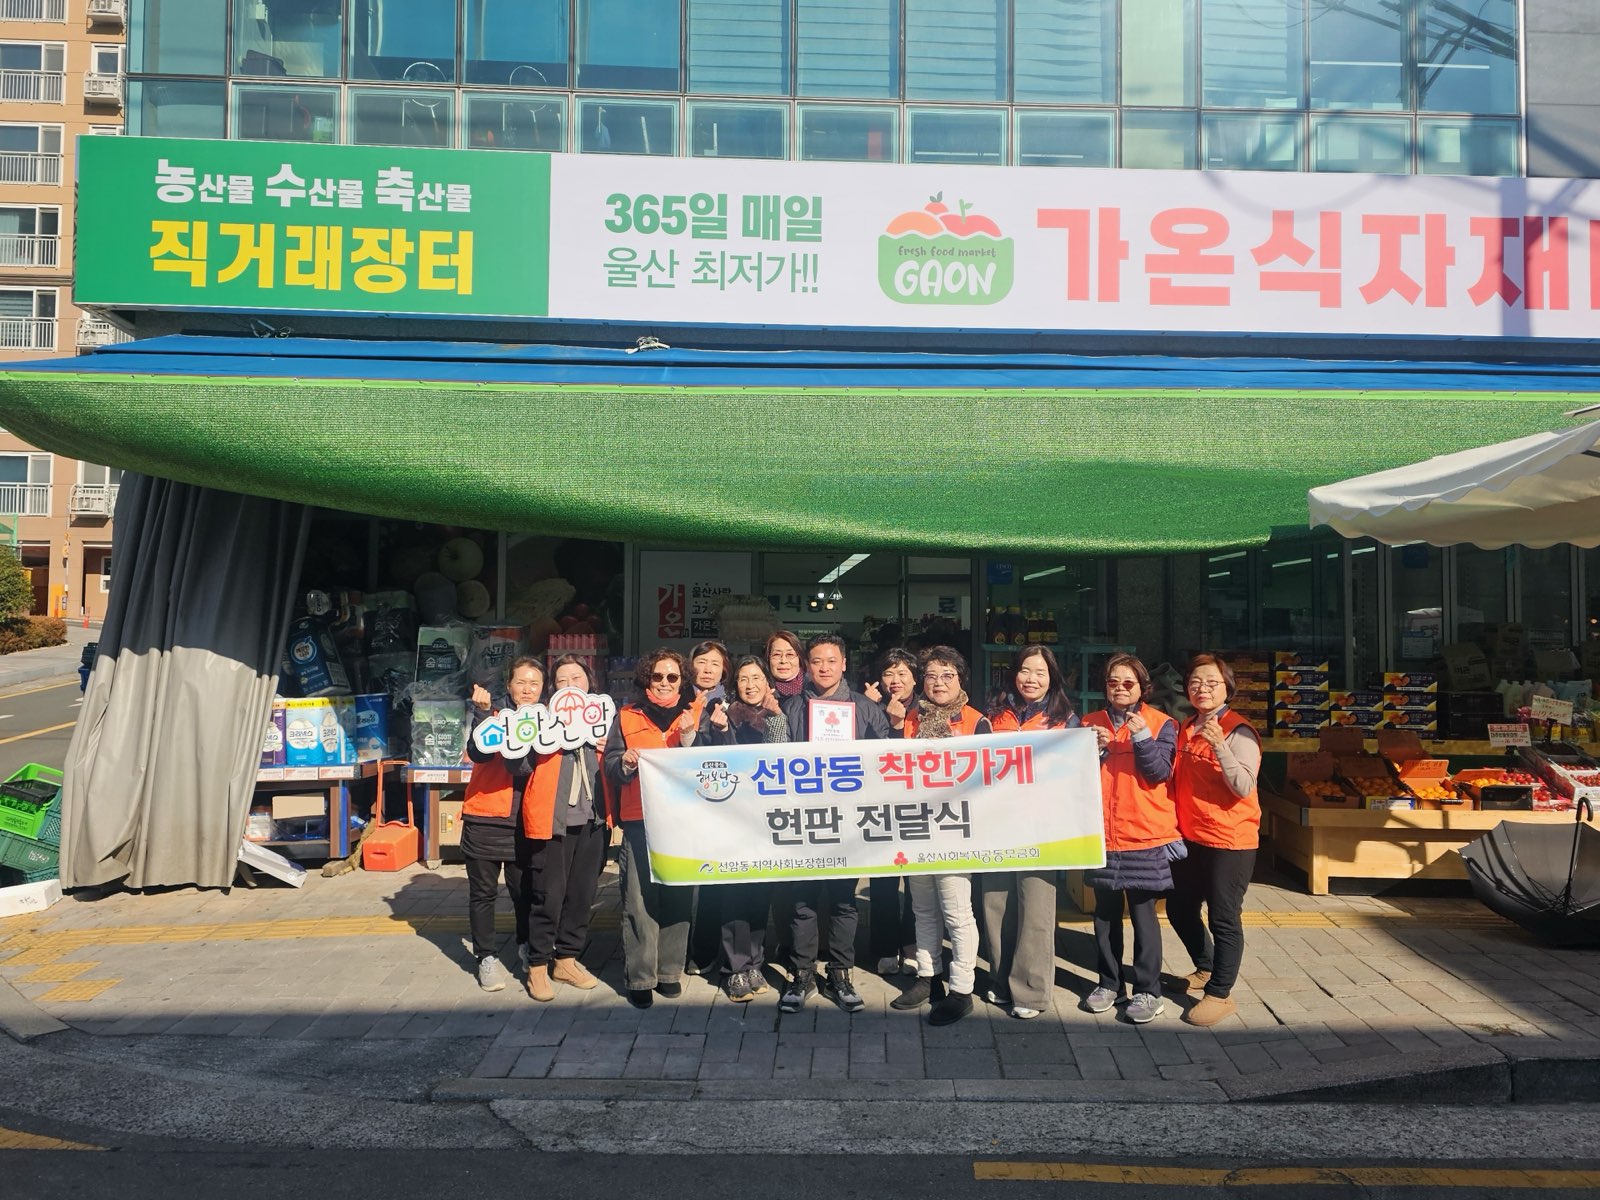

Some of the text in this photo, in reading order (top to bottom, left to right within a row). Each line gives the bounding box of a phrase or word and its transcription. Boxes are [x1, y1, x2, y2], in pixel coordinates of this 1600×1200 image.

[155, 158, 472, 213] 농산물 수산물 축산물
[604, 192, 822, 242] 365일 매일
[149, 220, 474, 295] 직거래장터
[603, 246, 819, 294] 울산 최저가!!
[898, 245, 996, 258] fresh food market
[1036, 206, 1600, 312] 가온식자재
[894, 259, 997, 297] GAON
[696, 770, 740, 793] 행복남구
[750, 744, 1035, 796] 선암동 착한가게
[766, 799, 972, 845] 현판 전달식
[718, 856, 848, 873] 선암동 지역사회보장협의체
[917, 847, 1040, 863] 울산사회복지공동모금회
